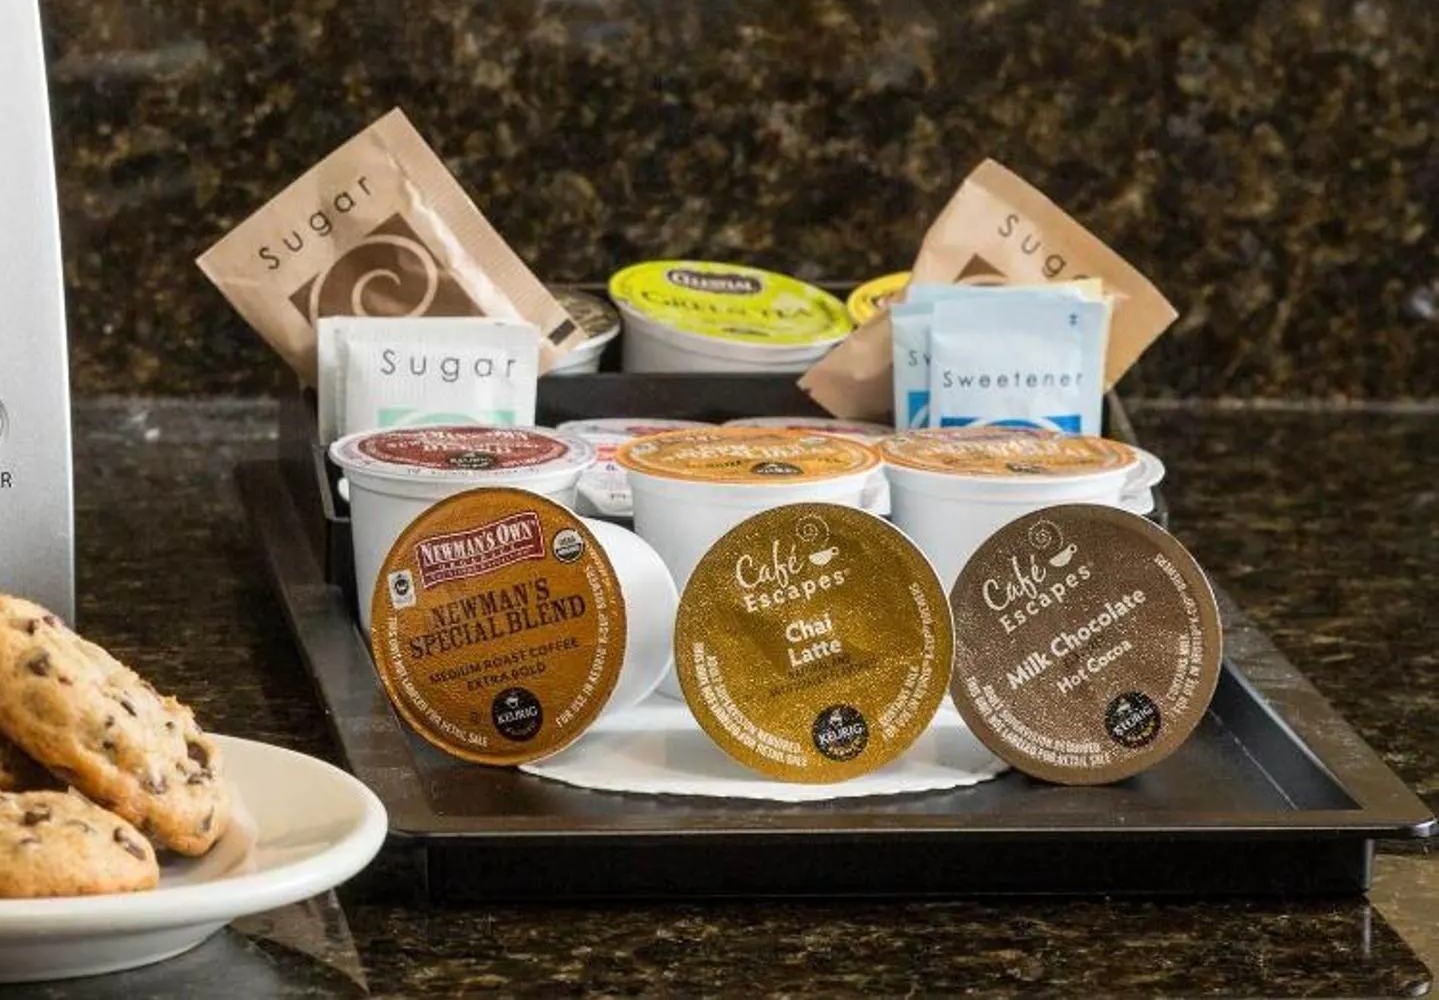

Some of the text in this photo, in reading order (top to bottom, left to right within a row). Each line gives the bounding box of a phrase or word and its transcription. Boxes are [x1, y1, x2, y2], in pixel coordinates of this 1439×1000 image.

[259, 175, 374, 270] Sugar
[998, 214, 1088, 280] Sug
[380, 349, 517, 383] Sugar
[943, 371, 1083, 388] Sweetener
[420, 530, 495, 568] NEWMAN'S
[496, 520, 533, 547] OWN
[736, 540, 804, 588] Café
[430, 577, 550, 630] NEWMAN'S
[744, 570, 845, 613] Escapes
[983, 555, 1046, 610] Café
[999, 565, 1090, 634] Escapes
[410, 594, 587, 659] SPECIAL BLEND
[786, 612, 832, 643] Chai
[1006, 590, 1146, 690] Milk Chocolate
[788, 639, 842, 668] Latte
[1057, 640, 1133, 694] Hot Cocoa
[497, 705, 539, 725] KEURIG
[818, 723, 864, 745] KEURIG
